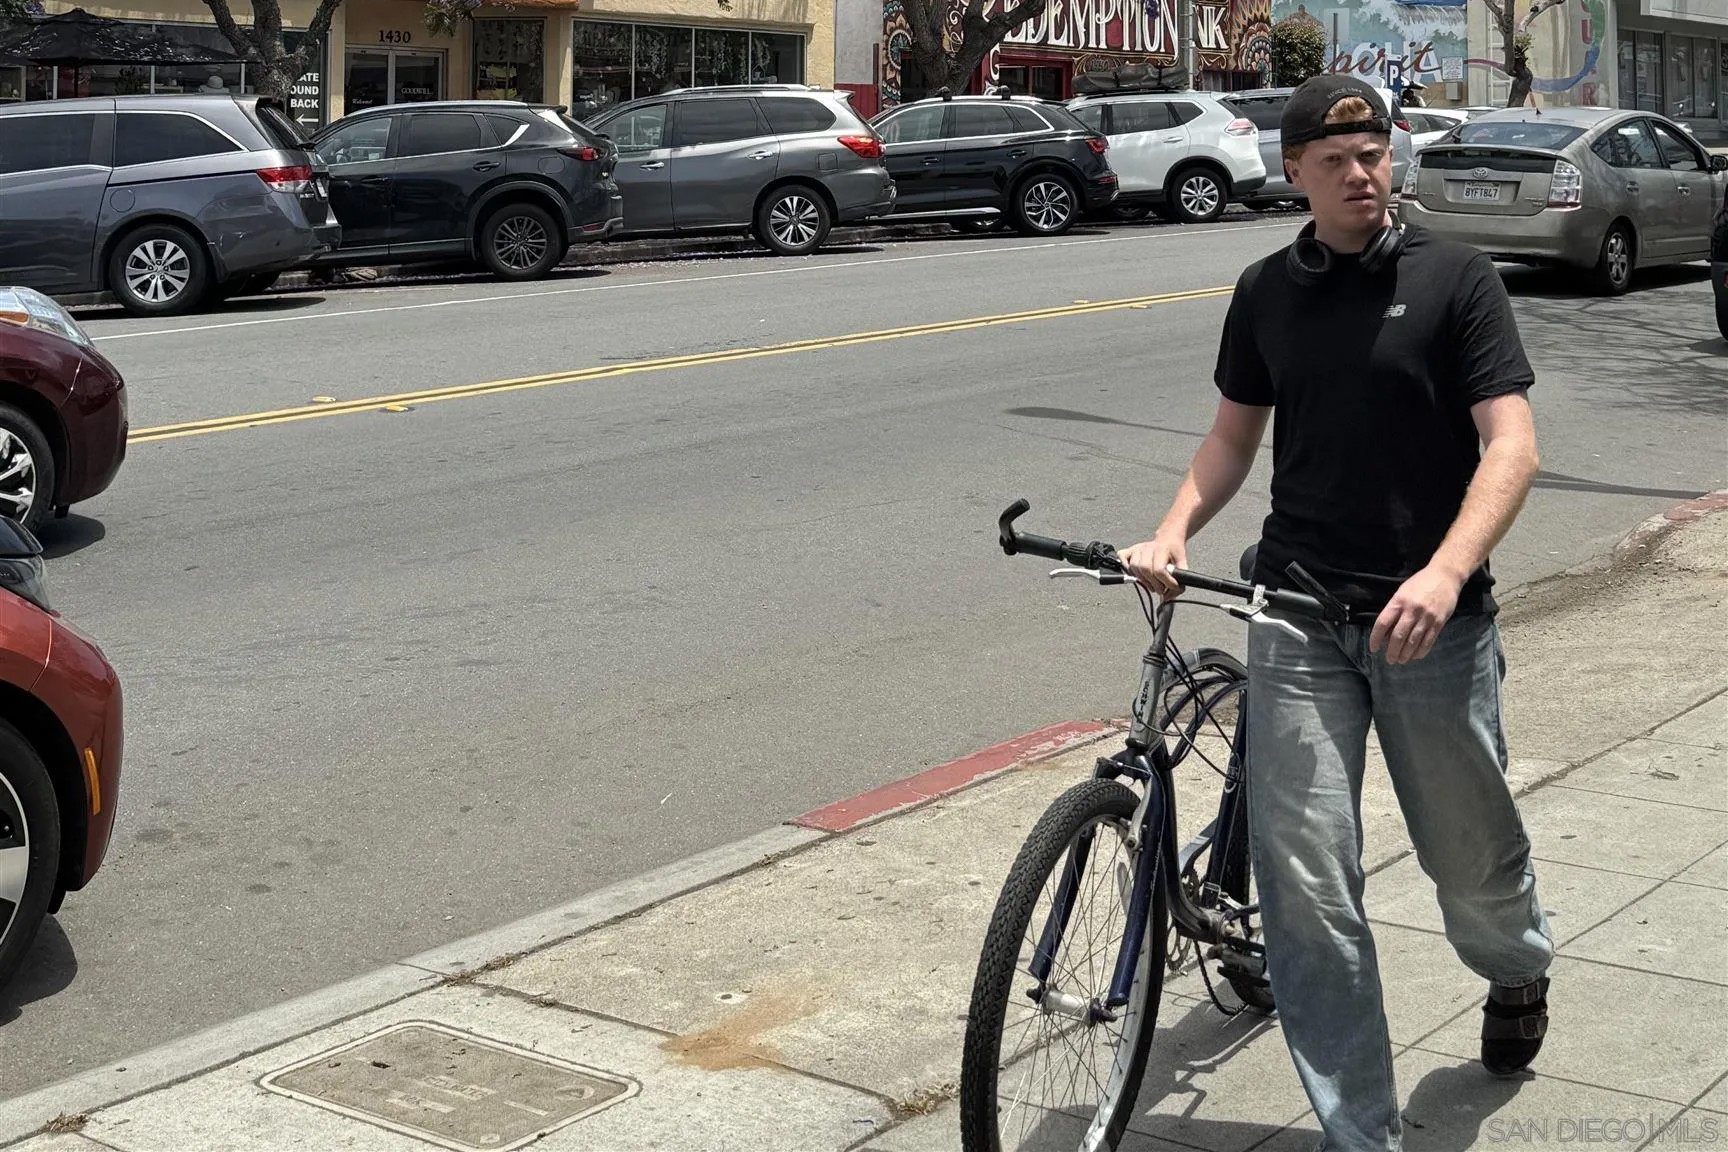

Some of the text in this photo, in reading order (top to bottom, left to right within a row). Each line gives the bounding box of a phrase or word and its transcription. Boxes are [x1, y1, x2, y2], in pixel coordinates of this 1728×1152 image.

[1191, 4, 1229, 48] NK
[379, 30, 411, 44] 1430
[298, 73, 319, 82] ATE
[1390, 65, 1399, 86] P
[291, 86, 319, 95] OUND
[291, 99, 319, 108] BACK
